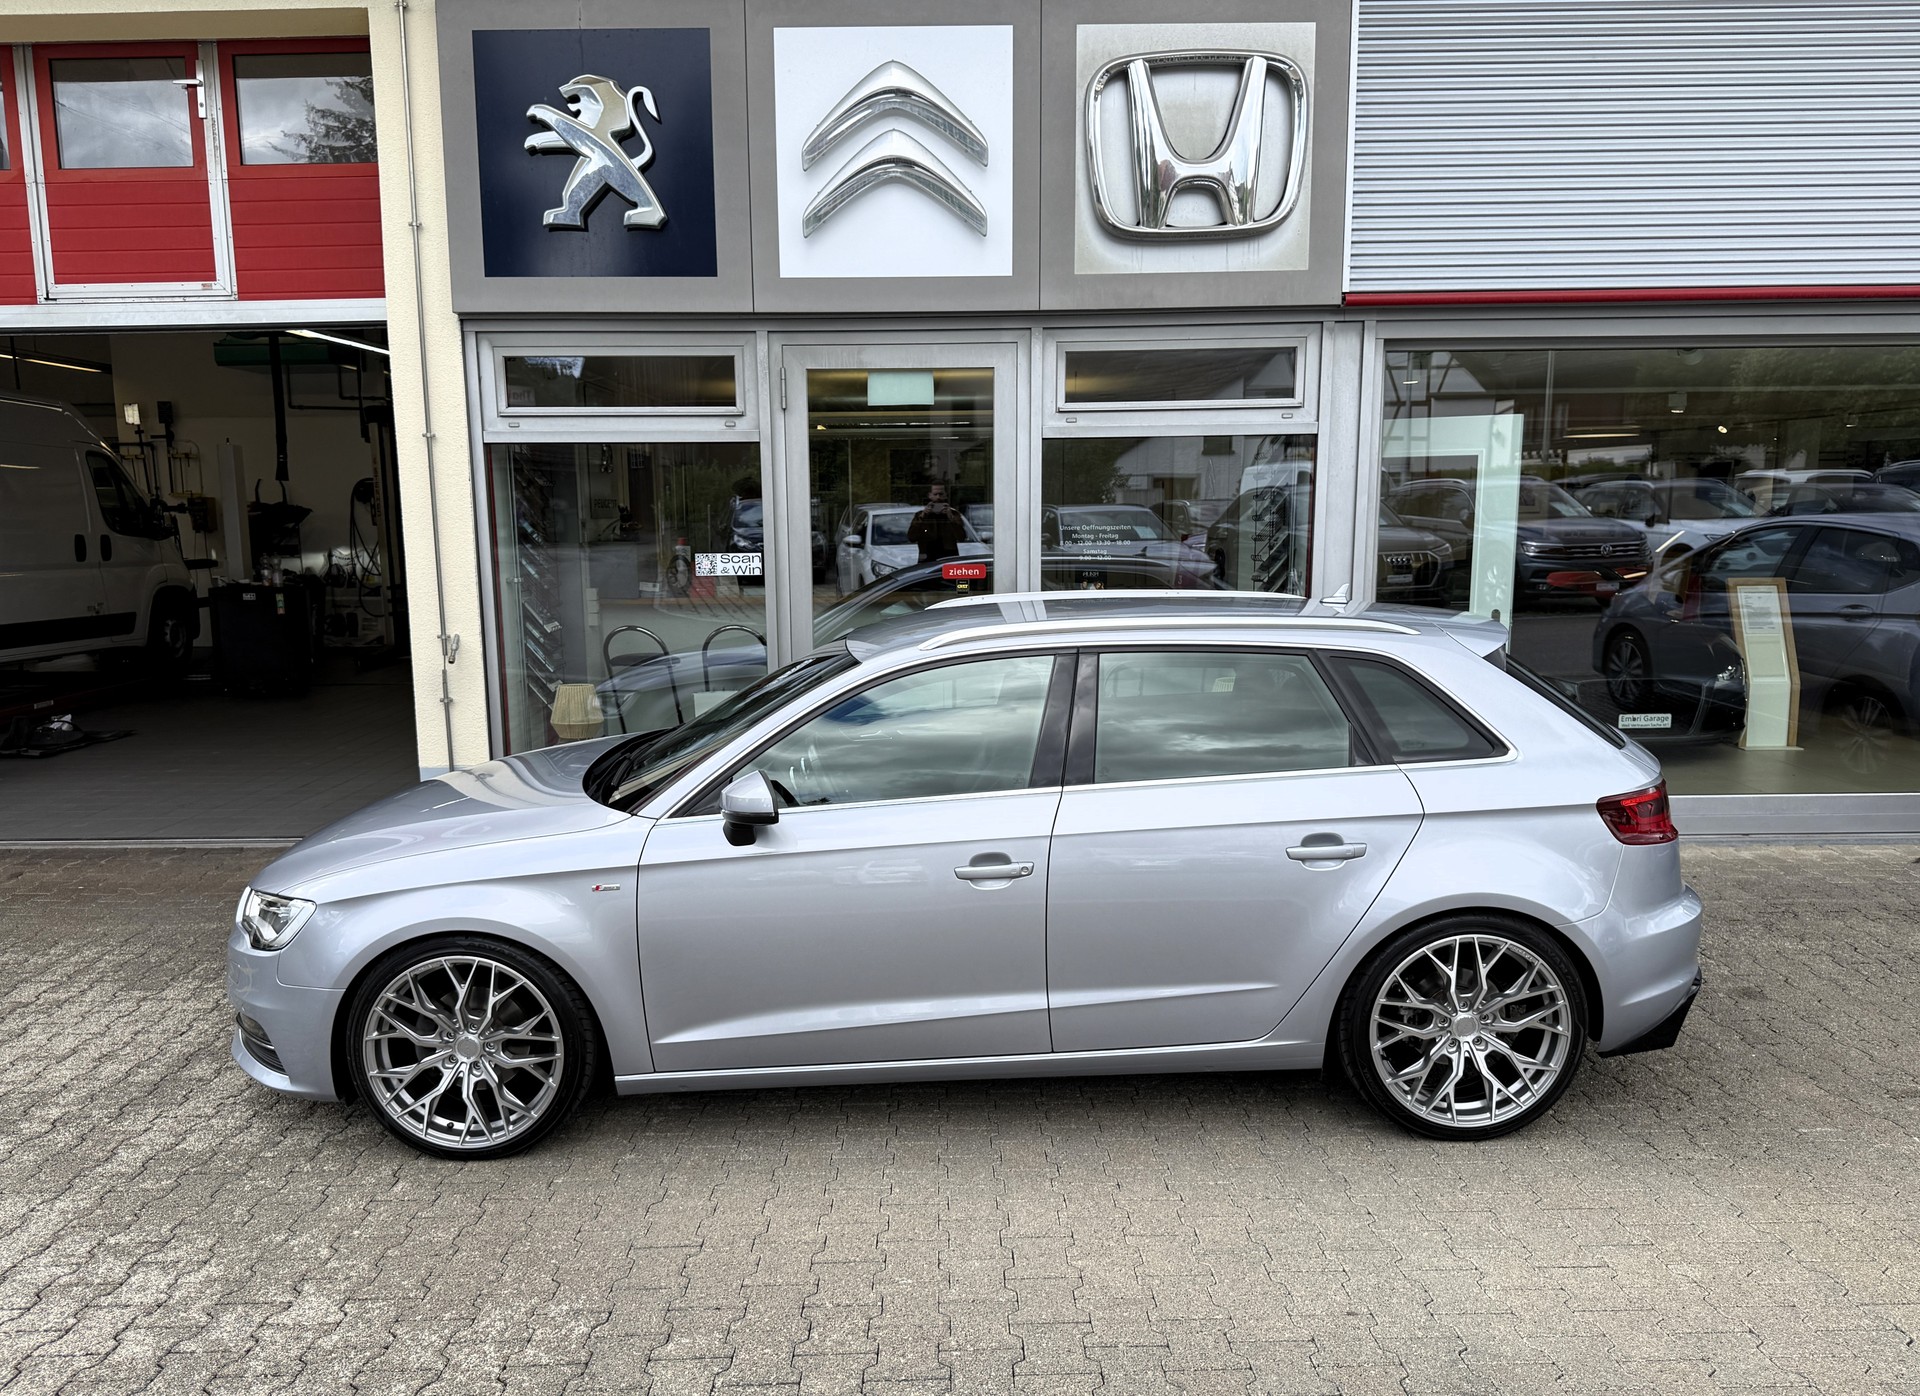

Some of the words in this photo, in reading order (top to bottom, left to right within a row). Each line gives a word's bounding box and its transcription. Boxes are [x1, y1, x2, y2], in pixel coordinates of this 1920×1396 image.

[1081, 524, 1131, 532] Oeffnungszeiten
[720, 553, 762, 564] Scan
[720, 566, 730, 574] &
[732, 563, 762, 575] Win
[949, 567, 980, 576] ziehen
[1643, 714, 1670, 723] Garage
